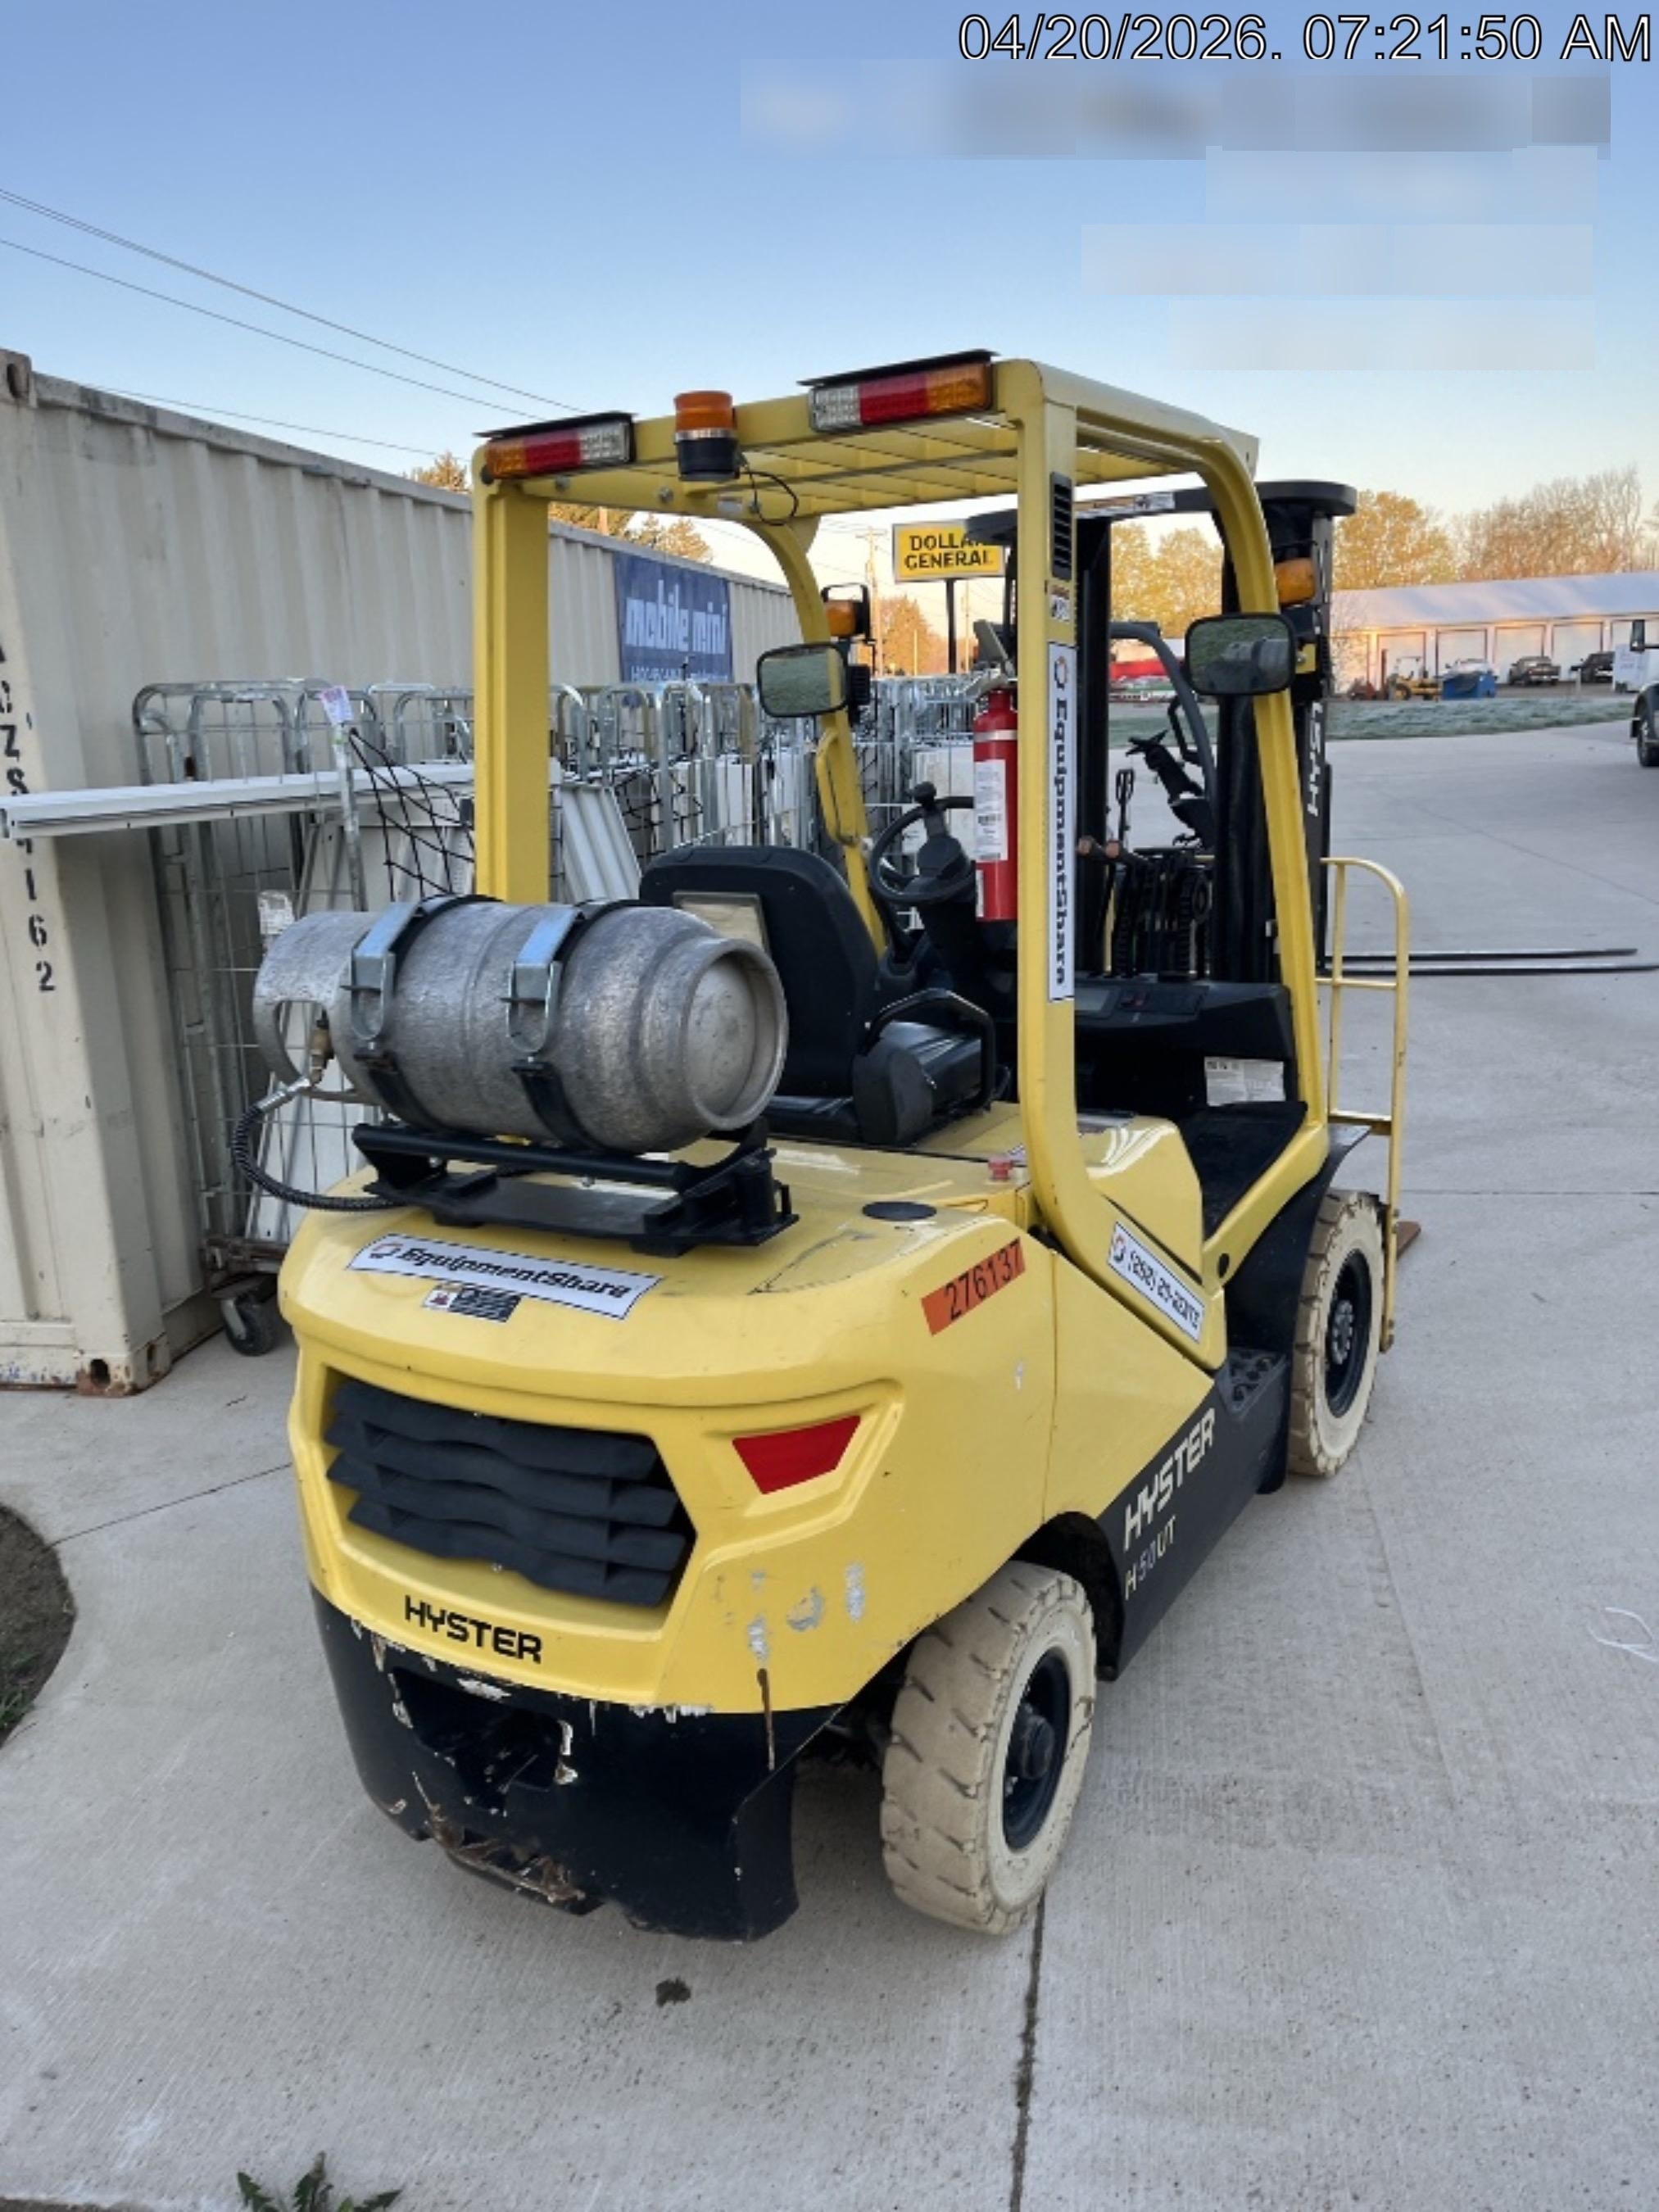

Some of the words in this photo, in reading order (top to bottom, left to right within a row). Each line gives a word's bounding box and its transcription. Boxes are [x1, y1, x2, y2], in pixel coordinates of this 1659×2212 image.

[904, 550, 993, 570] GENERAL
[909, 533, 982, 551] DOLLA
[1054, 697, 1068, 985] EquipmentShare
[399, 1247, 633, 1299] EquipmentShare
[944, 1237, 1020, 1322] 276137
[1123, 1407, 1215, 1552] HYSTER
[405, 1594, 542, 1665] HYSTER
